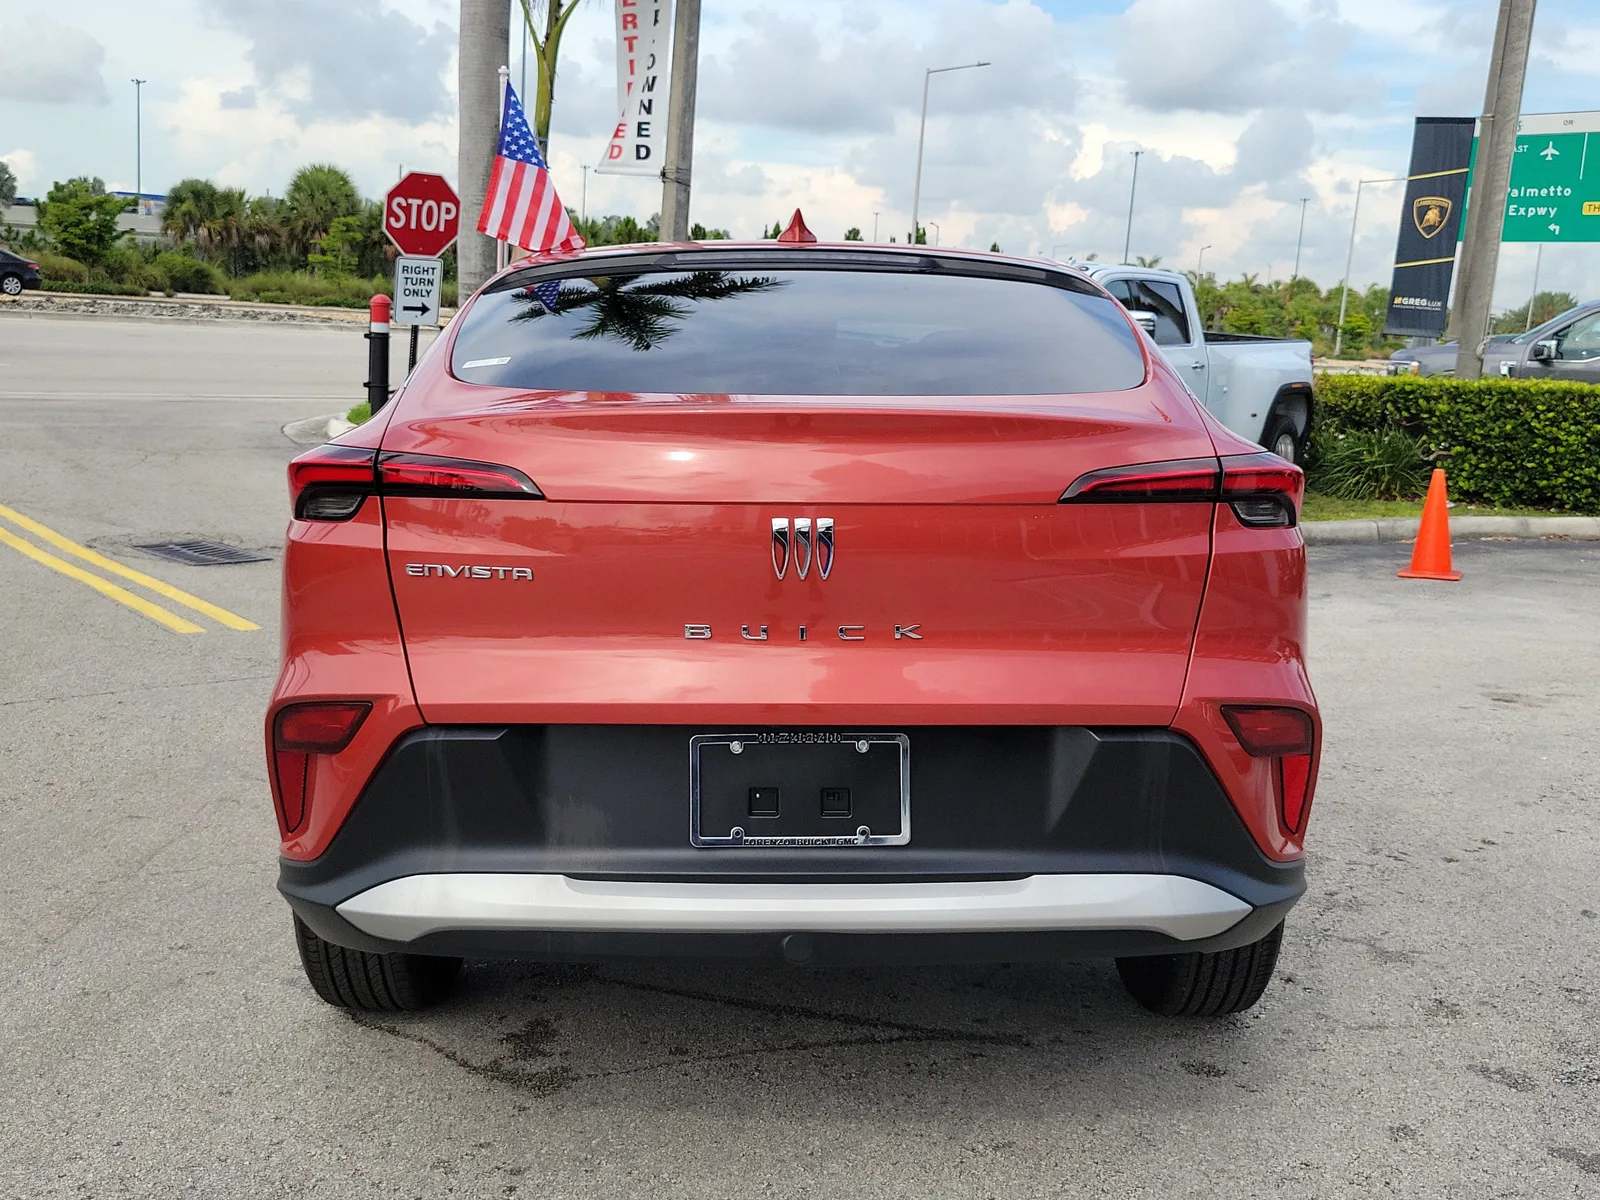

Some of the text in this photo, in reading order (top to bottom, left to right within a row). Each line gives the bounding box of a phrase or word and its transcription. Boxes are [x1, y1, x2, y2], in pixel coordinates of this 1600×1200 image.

[608, 0, 639, 161] RTIED
[388, 196, 457, 232] STOP
[1508, 204, 1558, 218] Expwy
[402, 265, 437, 276] RIGHT
[403, 277, 435, 287] TURN
[403, 288, 432, 298] ONLY
[405, 563, 534, 581] ENVISTA
[684, 623, 924, 641] BUICK
[743, 837, 859, 846] LORENZO BUICK GMC
